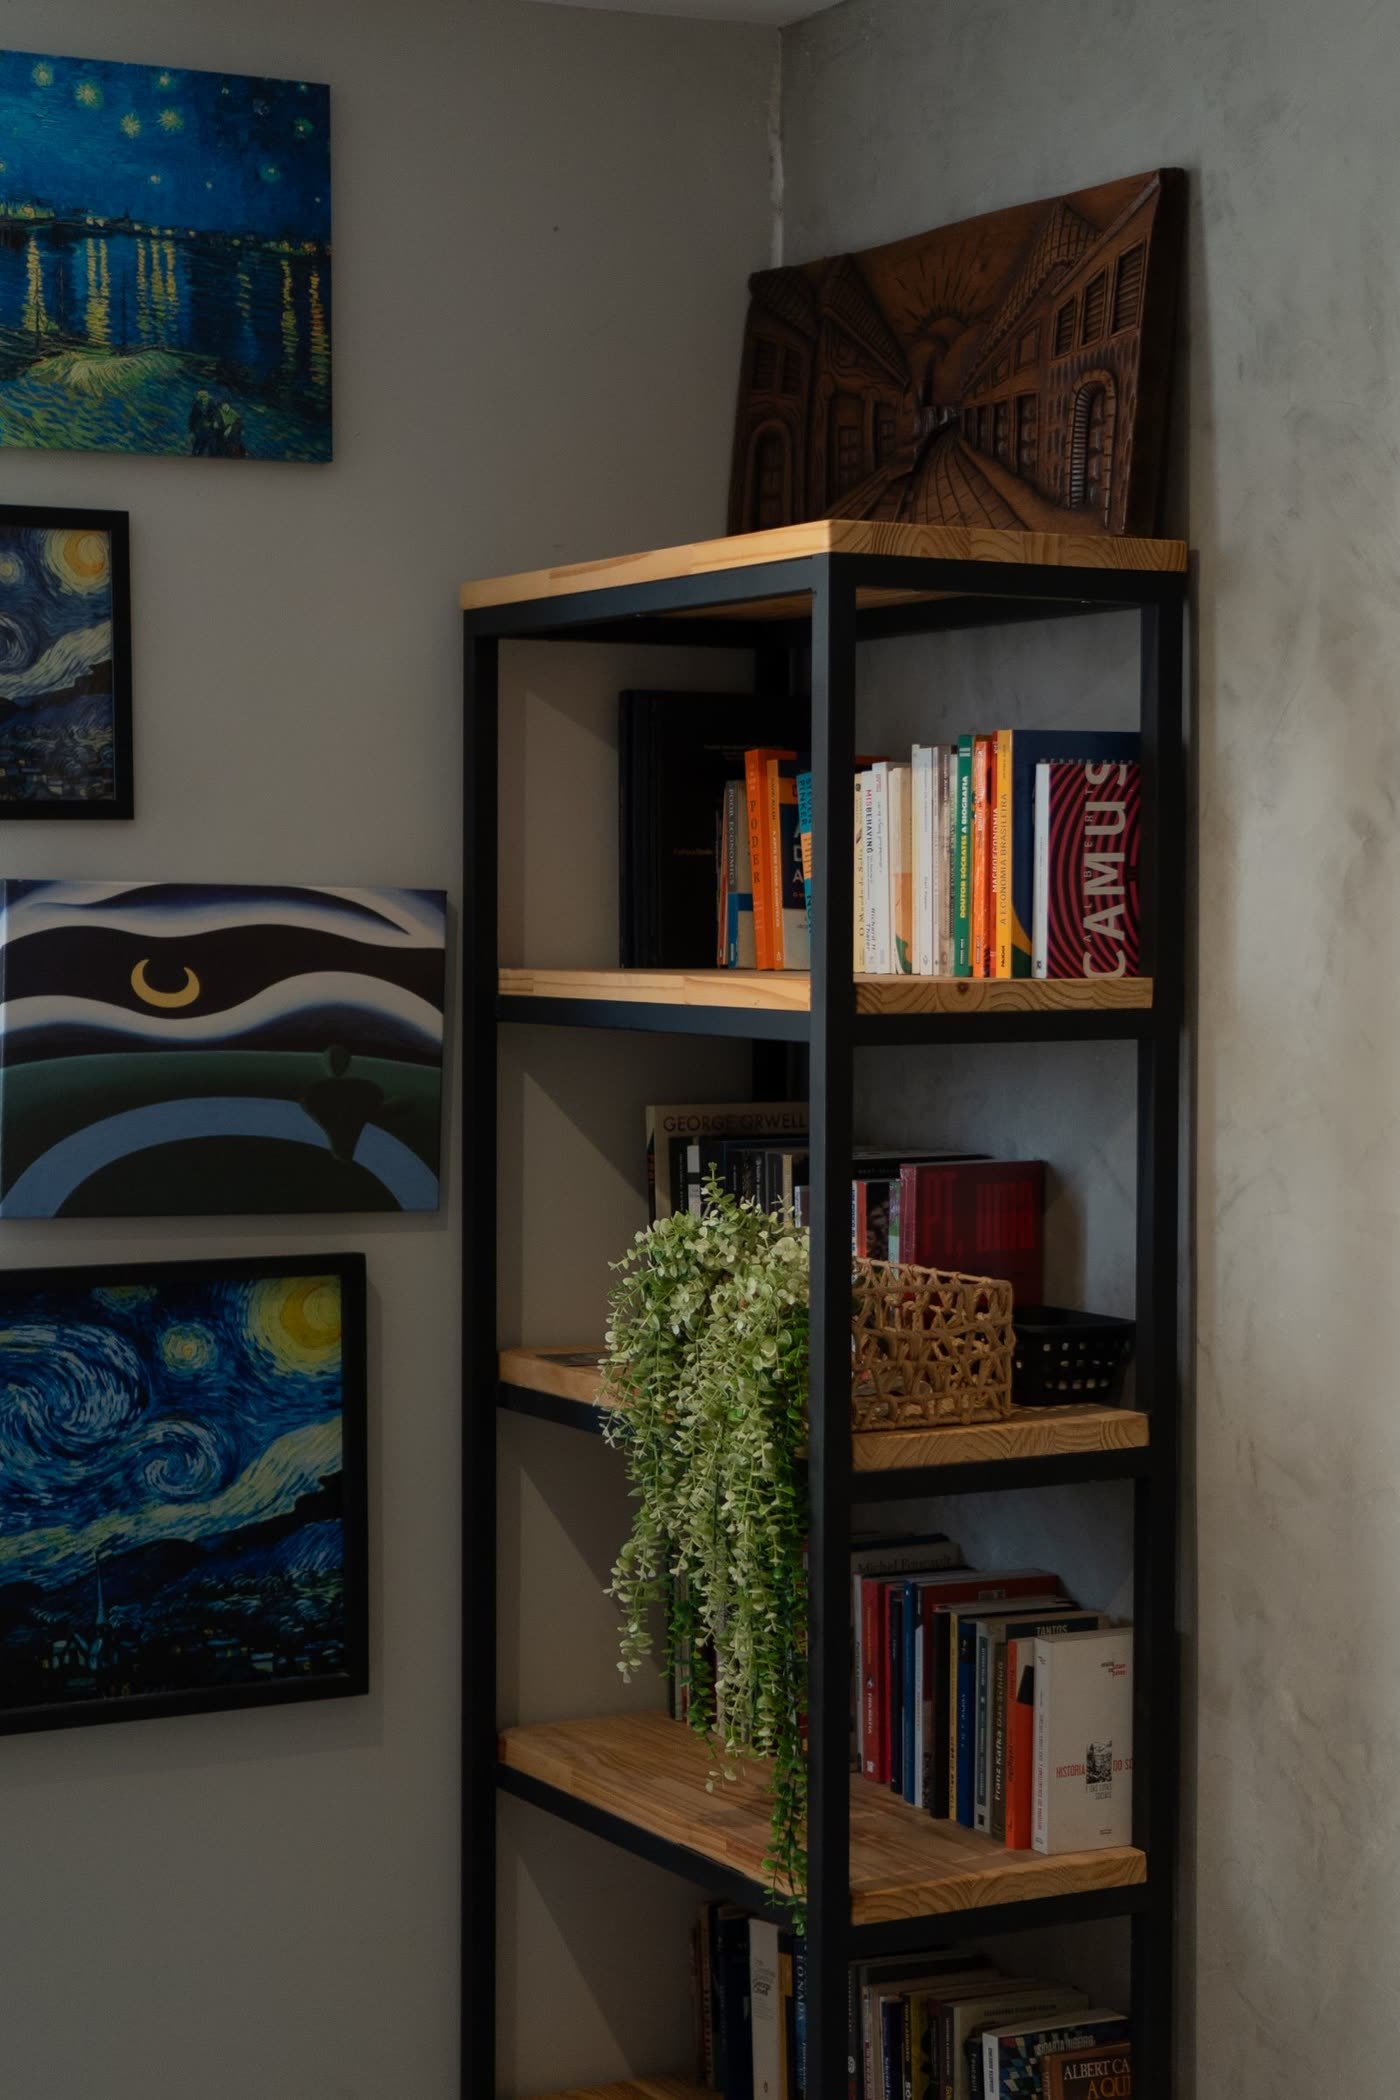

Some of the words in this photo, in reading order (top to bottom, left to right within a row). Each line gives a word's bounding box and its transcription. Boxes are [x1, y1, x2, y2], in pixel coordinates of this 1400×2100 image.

[727, 787, 735, 817] POOR
[799, 779, 807, 826] PINKER
[864, 788, 873, 854] MISBEHAVING
[960, 775, 969, 825] BIOGRAFIA
[727, 820, 736, 886] ECONOMICS
[749, 799, 762, 884] PODER
[959, 835, 968, 879] SÓCRATES
[1082, 762, 1127, 978] CAMUS
[1084, 789, 1094, 942] ALBERT
[960, 880, 968, 918] DOUTOR
[663, 1114, 738, 1132] GEORGE
[740, 1112, 808, 1130] ORWELL
[1112, 1759, 1122, 1772] DO
[796, 1978, 805, 2022] NADA
[1064, 2060, 1110, 2080] ALBERT
[1088, 2080, 1099, 2098] A
